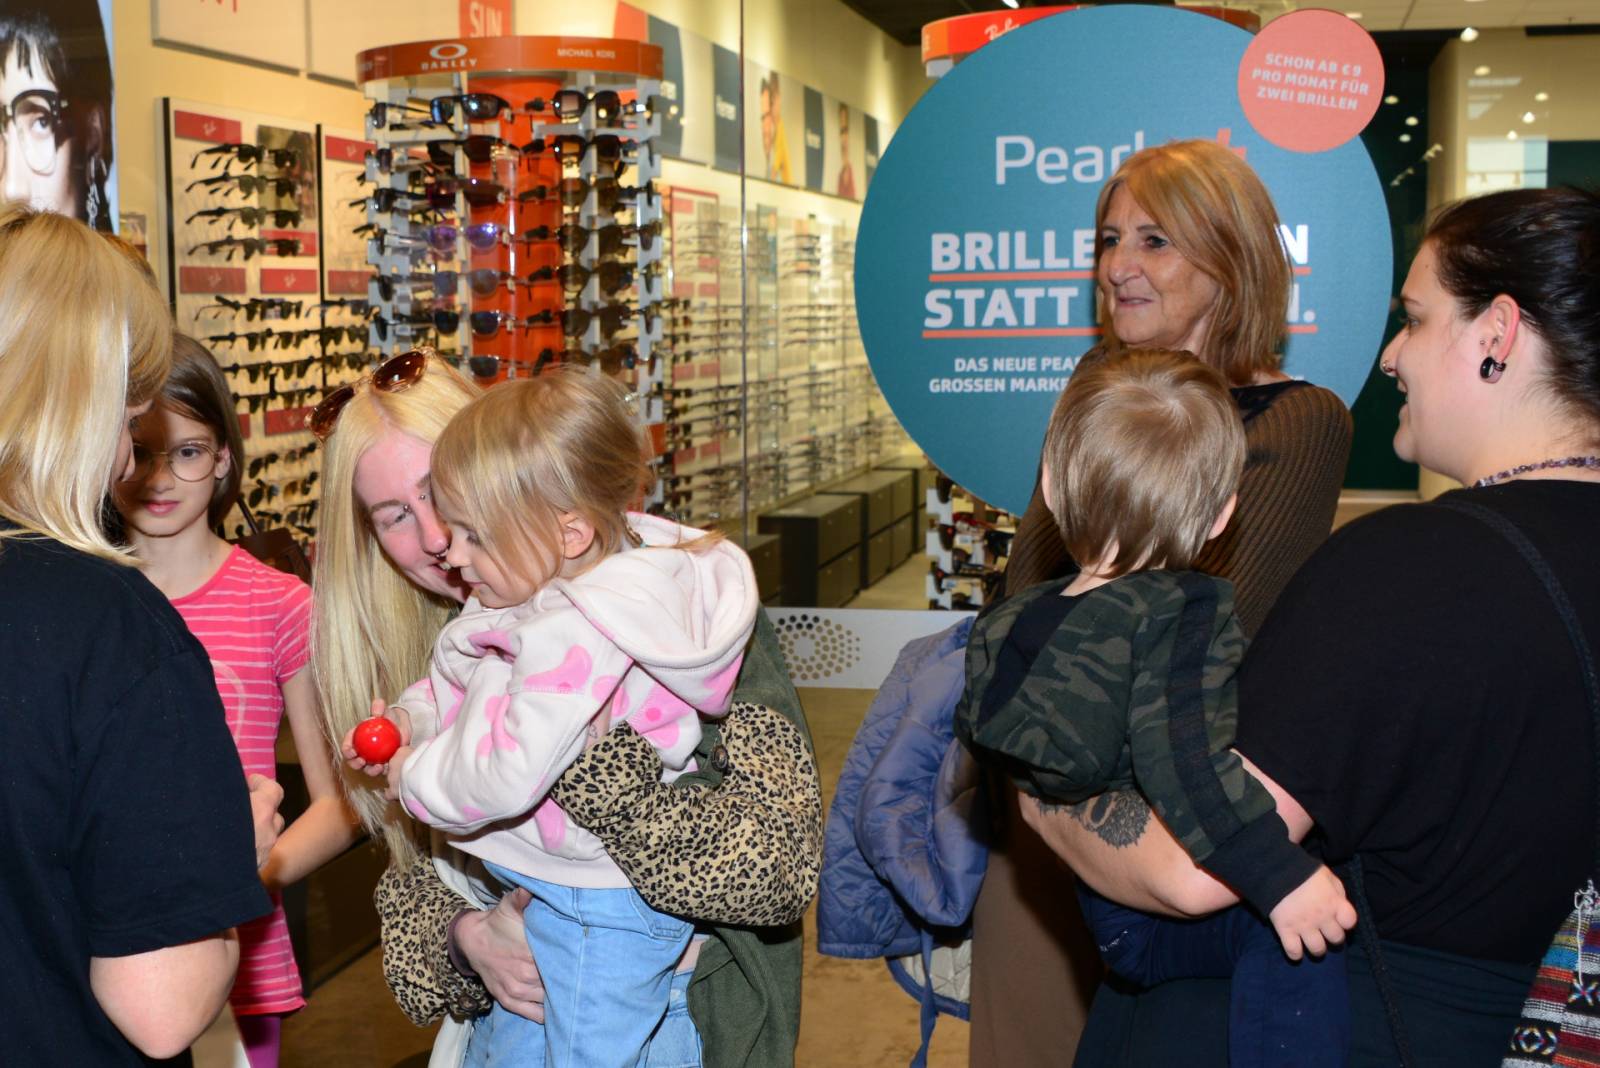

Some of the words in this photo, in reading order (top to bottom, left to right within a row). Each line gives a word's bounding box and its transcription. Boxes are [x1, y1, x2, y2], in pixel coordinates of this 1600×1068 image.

[1265, 53, 1315, 70] SCHON
[1318, 60, 1338, 73] AB
[1252, 67, 1282, 83] PRO
[1285, 73, 1338, 90] MONAT
[1341, 79, 1369, 95] FÜR
[1257, 86, 1294, 102] ZWEI
[1297, 91, 1358, 110] BRILLEN
[924, 286, 1079, 328] STATT
[954, 357, 988, 372] DAS
[993, 356, 1037, 372] NEUE
[929, 378, 1005, 393] GROSSEN
